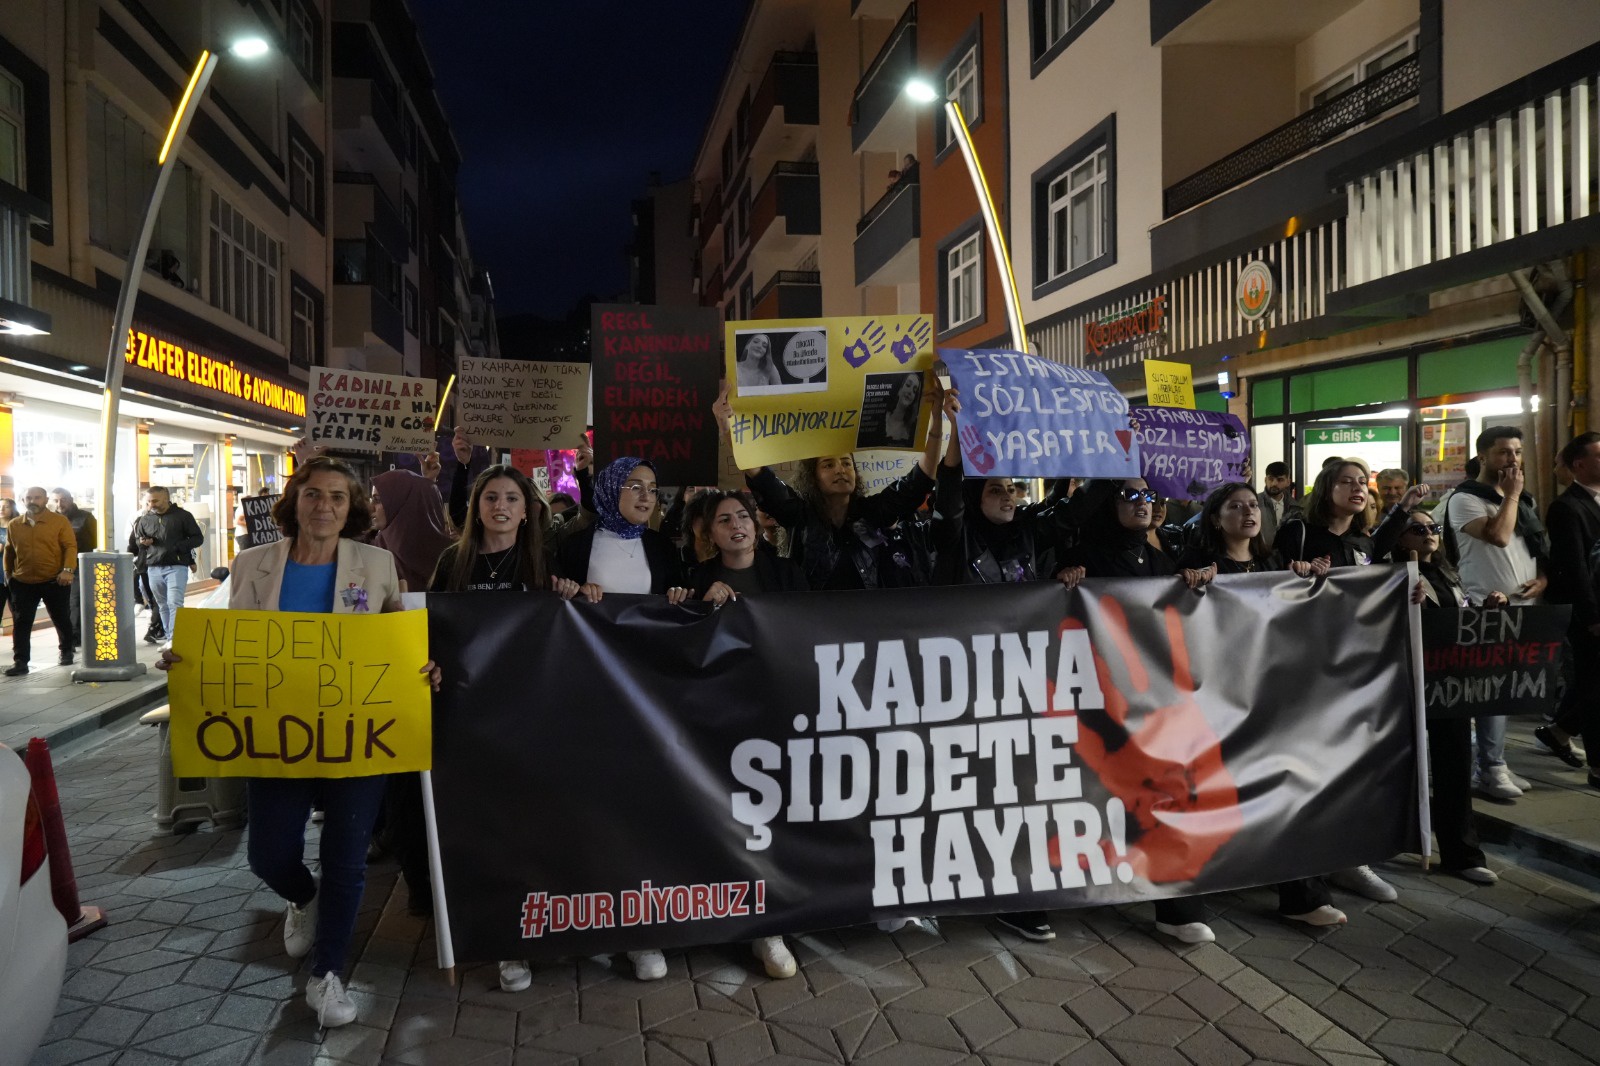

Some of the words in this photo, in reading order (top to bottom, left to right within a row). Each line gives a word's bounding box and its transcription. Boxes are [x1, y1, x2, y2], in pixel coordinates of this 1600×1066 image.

[601, 311, 653, 331] REGL
[1133, 334, 1159, 353] market
[136, 331, 185, 379] ZAFER
[187, 351, 242, 398] ELEKTRİK
[243, 373, 252, 400] &
[252, 377, 307, 418] AYDINLATMA
[461, 375, 495, 385] KADINI
[502, 378, 525, 388] SEN
[532, 378, 563, 390] YERDE
[462, 361, 475, 371] EY
[482, 361, 548, 374] KAHRAMAN
[553, 365, 581, 375] TÜRK
[964, 351, 1109, 387] İSTANBUL
[319, 372, 424, 398] KADINLAR
[462, 389, 521, 399] SÜRÜNMEYE
[531, 390, 562, 399] DEĞİL
[313, 392, 401, 411] ÇOCUKLAR
[463, 402, 508, 411] OMUZLAR
[513, 402, 558, 411] ÜZERİNDE
[312, 410, 395, 429] YATTAN
[311, 425, 381, 446] ÇERMİŞ
[1332, 429, 1362, 443] GİRİŞ
[201, 619, 342, 660] NEDEN
[1456, 607, 1523, 646] BEN
[1424, 639, 1563, 672] UMHURİYET
[200, 661, 284, 709] HEP
[318, 661, 392, 708] BİZ
[814, 628, 1104, 732] KADINA
[196, 711, 397, 764] ÖLDÜK
[730, 714, 1082, 851] ŞİDDETE
[870, 797, 1134, 907] HAYIR!
[520, 891, 615, 939] #DUR
